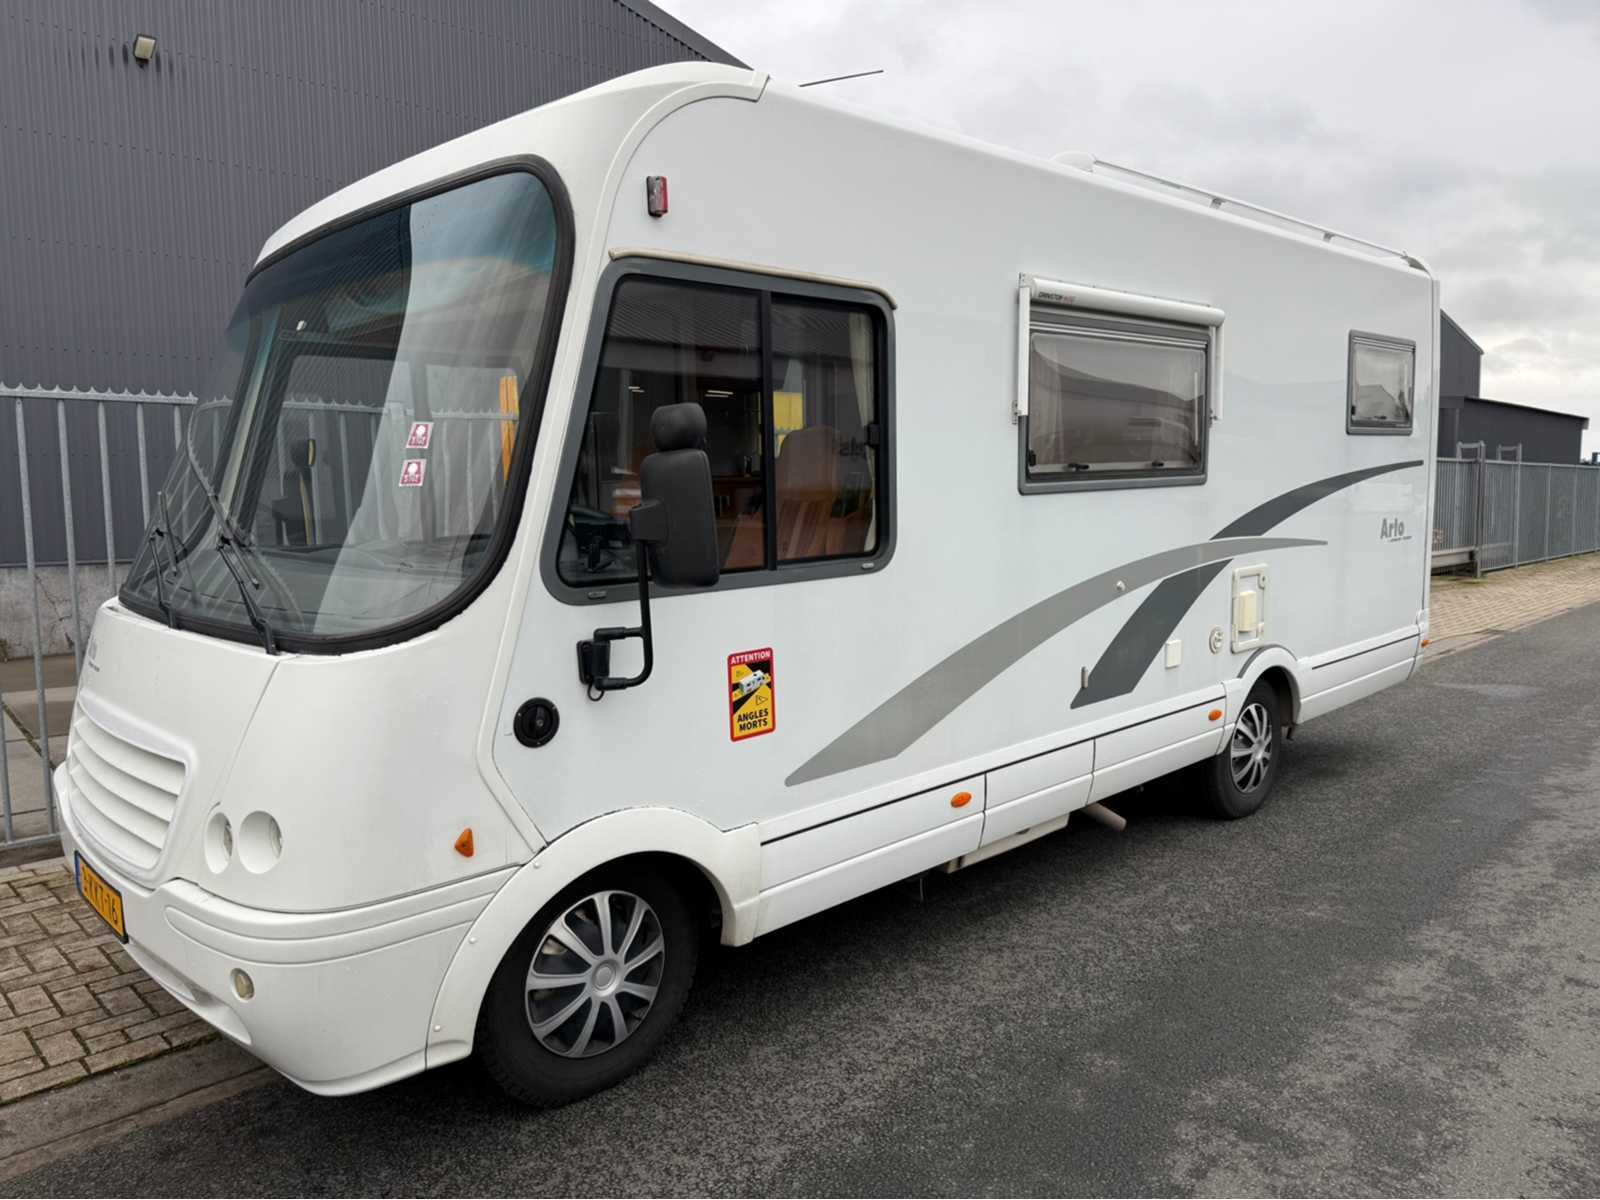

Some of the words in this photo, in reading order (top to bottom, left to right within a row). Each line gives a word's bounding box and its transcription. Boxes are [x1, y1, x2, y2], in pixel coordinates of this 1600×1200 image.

[731, 650, 770, 664] ATTENTION
[737, 708, 768, 723] ANGLES
[739, 718, 768, 731] MORTS
